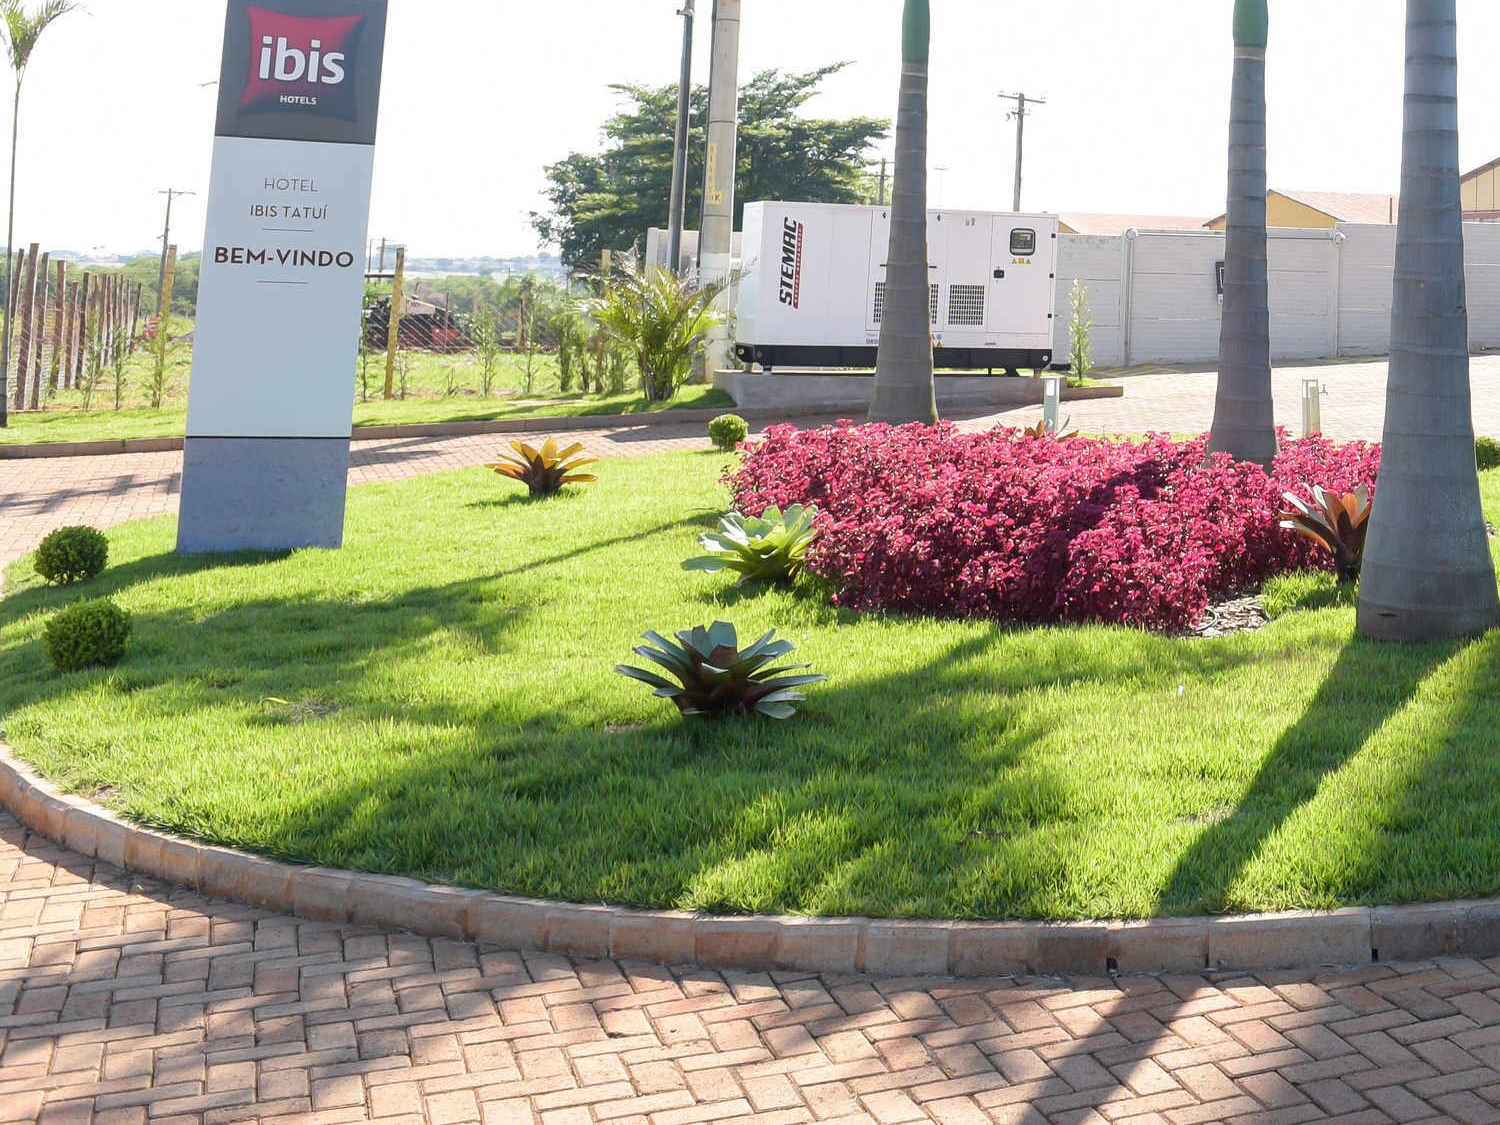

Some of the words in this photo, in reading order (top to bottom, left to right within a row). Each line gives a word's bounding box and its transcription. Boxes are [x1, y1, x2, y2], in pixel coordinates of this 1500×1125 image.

[259, 35, 345, 84] ibis
[280, 94, 317, 106] HOTELS
[264, 177, 318, 193] HOTEL
[250, 204, 278, 218] IBIS
[283, 203, 328, 220] TATUÍ
[214, 246, 354, 268] BEM-VINDO
[779, 217, 797, 305] STEMAC
